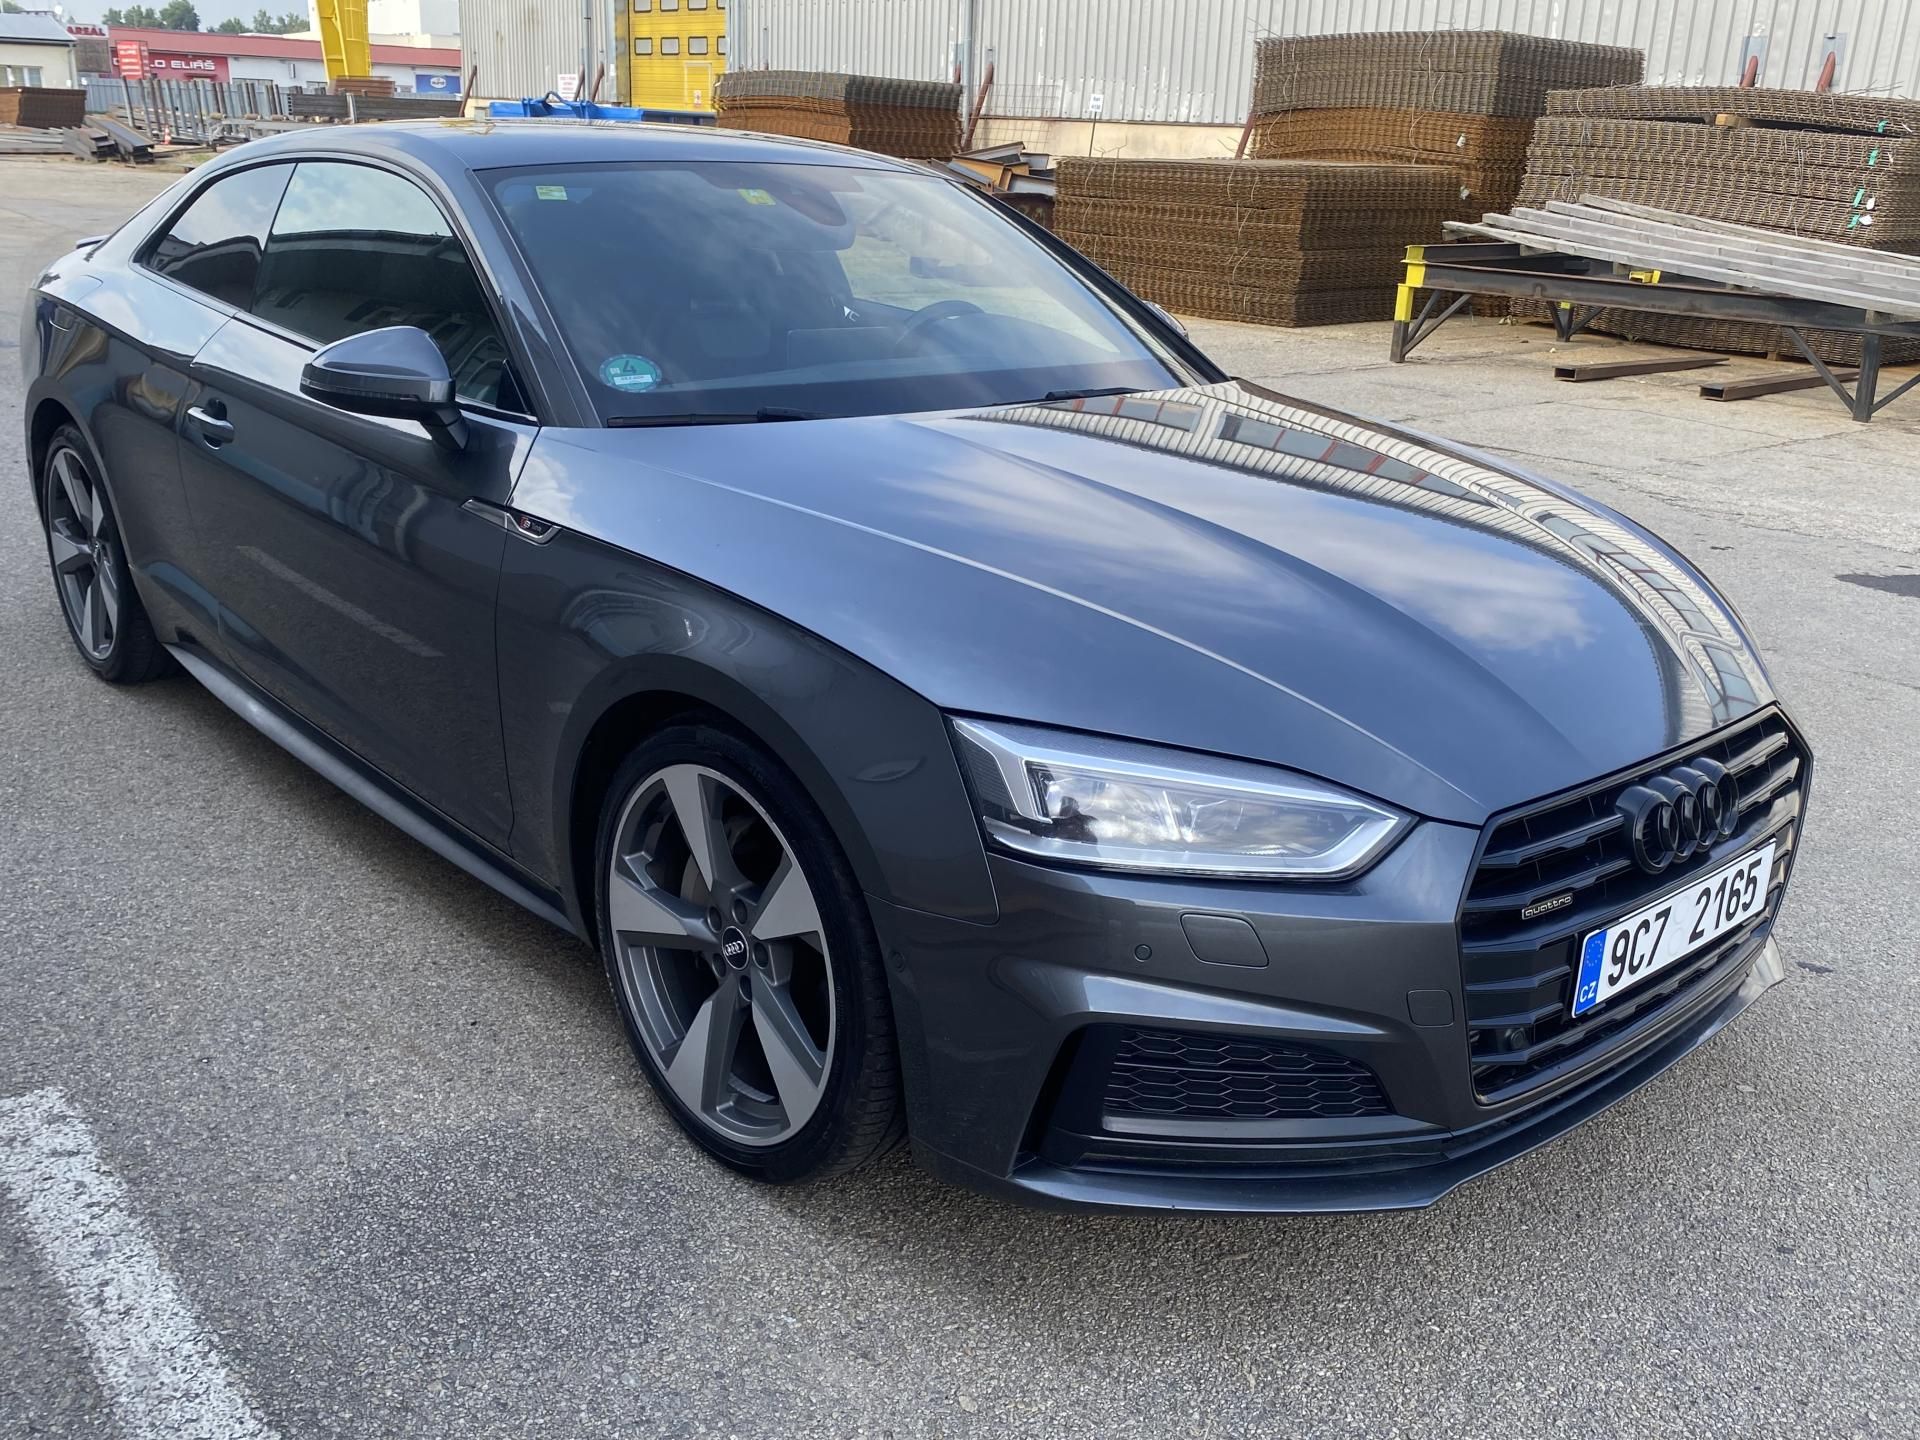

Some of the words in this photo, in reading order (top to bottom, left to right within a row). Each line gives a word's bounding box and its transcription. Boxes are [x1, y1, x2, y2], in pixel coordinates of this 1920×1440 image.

[170, 59, 216, 70] ELIÁŠ
[1525, 896, 1572, 917] quattro
[1608, 905, 1673, 987] 9C7
[1688, 856, 1763, 945] 2165
[1579, 981, 1597, 1003] CZ
